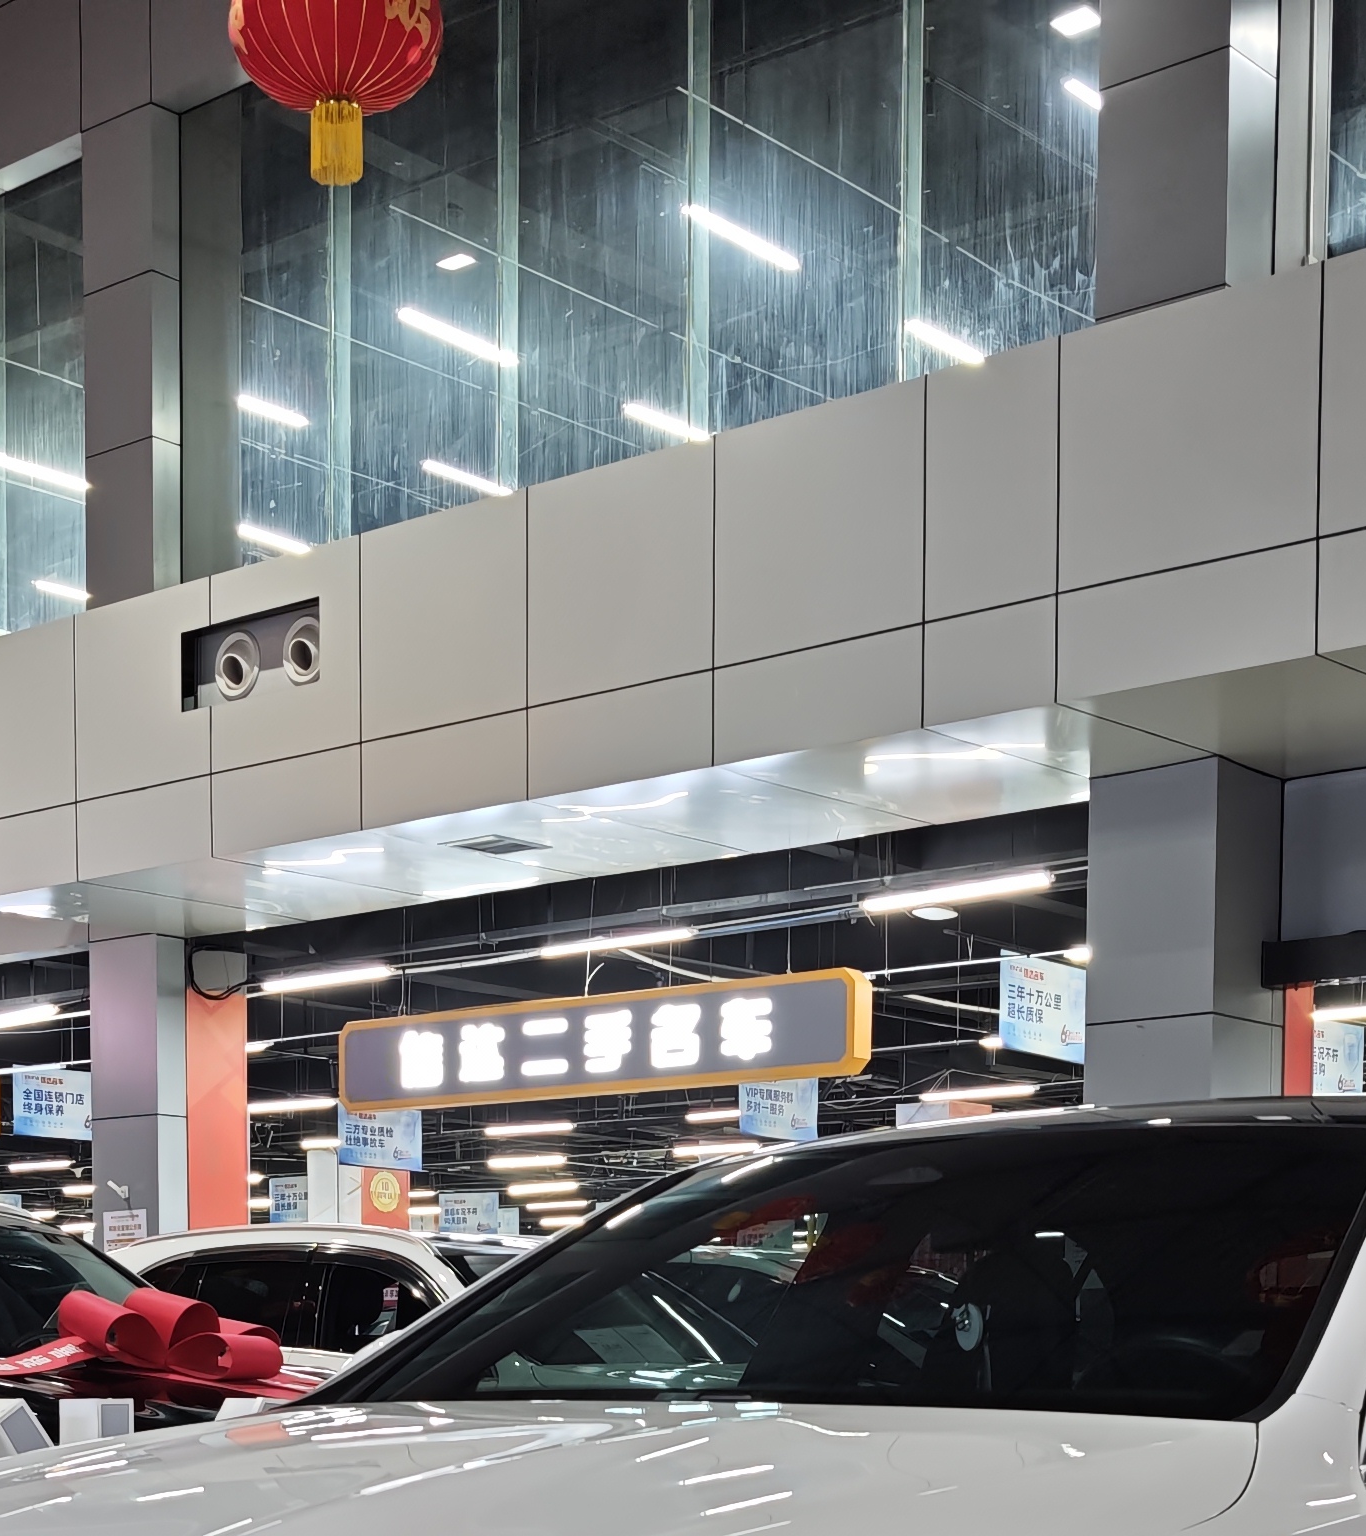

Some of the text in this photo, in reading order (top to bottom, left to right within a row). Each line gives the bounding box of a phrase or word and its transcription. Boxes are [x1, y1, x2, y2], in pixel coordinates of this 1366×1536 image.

[1008, 983, 1061, 1010] 三年十万公里
[1008, 1002, 1043, 1024] 超长质保
[399, 997, 773, 1090] 二手名车
[23, 1088, 84, 1105] 全国连锁门店
[745, 1086, 793, 1104] VIP专属服务群
[23, 1102, 64, 1116] 终身保养
[746, 1100, 785, 1116] 多对一服务
[345, 1123, 394, 1138] 三方专业质检
[345, 1135, 385, 1148] 杜绝事故车
